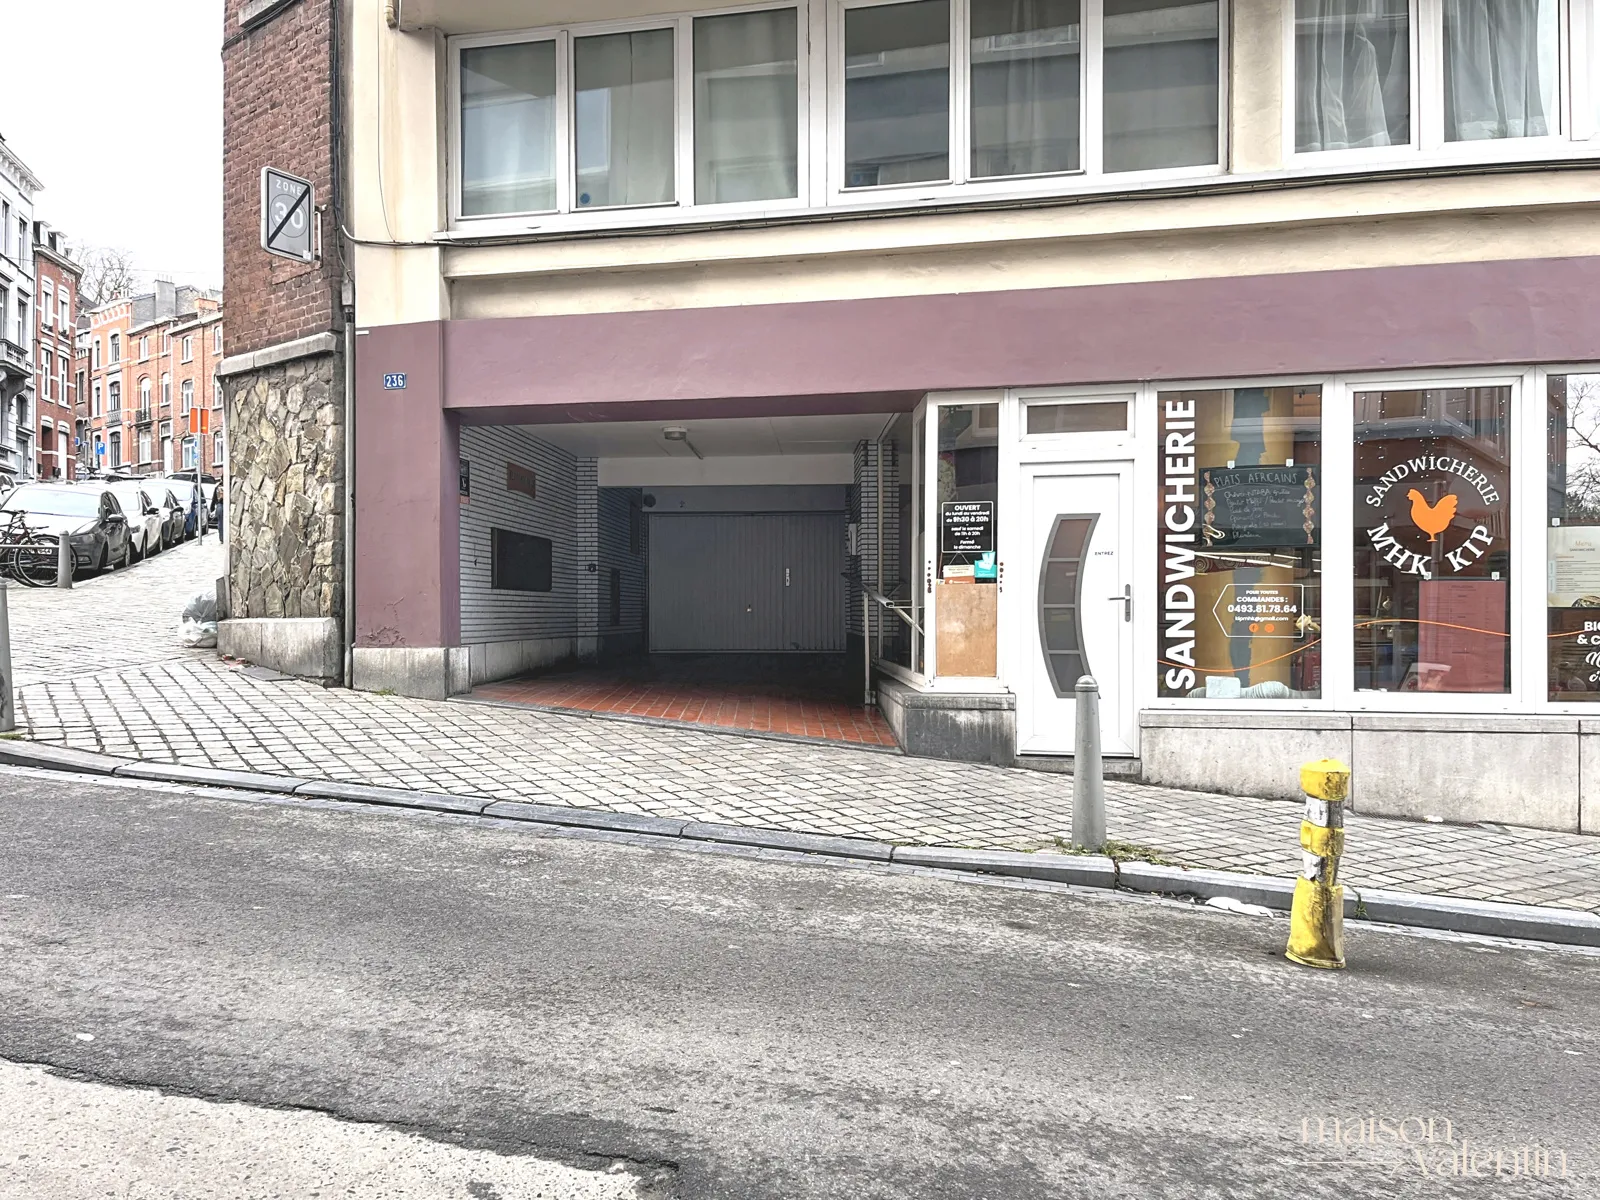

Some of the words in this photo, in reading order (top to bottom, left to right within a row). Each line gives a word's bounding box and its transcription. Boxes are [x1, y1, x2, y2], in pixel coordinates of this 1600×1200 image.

[276, 180, 303, 195] ZONE
[275, 202, 304, 229] 30
[386, 375, 404, 387] 236
[1213, 473, 1241, 487] PLATS
[1366, 456, 1500, 508] SANDWICHERIE
[1165, 399, 1196, 690] SANDWICHERIE
[1366, 522, 1432, 576] MHK
[1445, 525, 1494, 573] KIP
[1227, 604, 1298, 613] 0493.81.78.64
[1577, 633, 1588, 645] &
